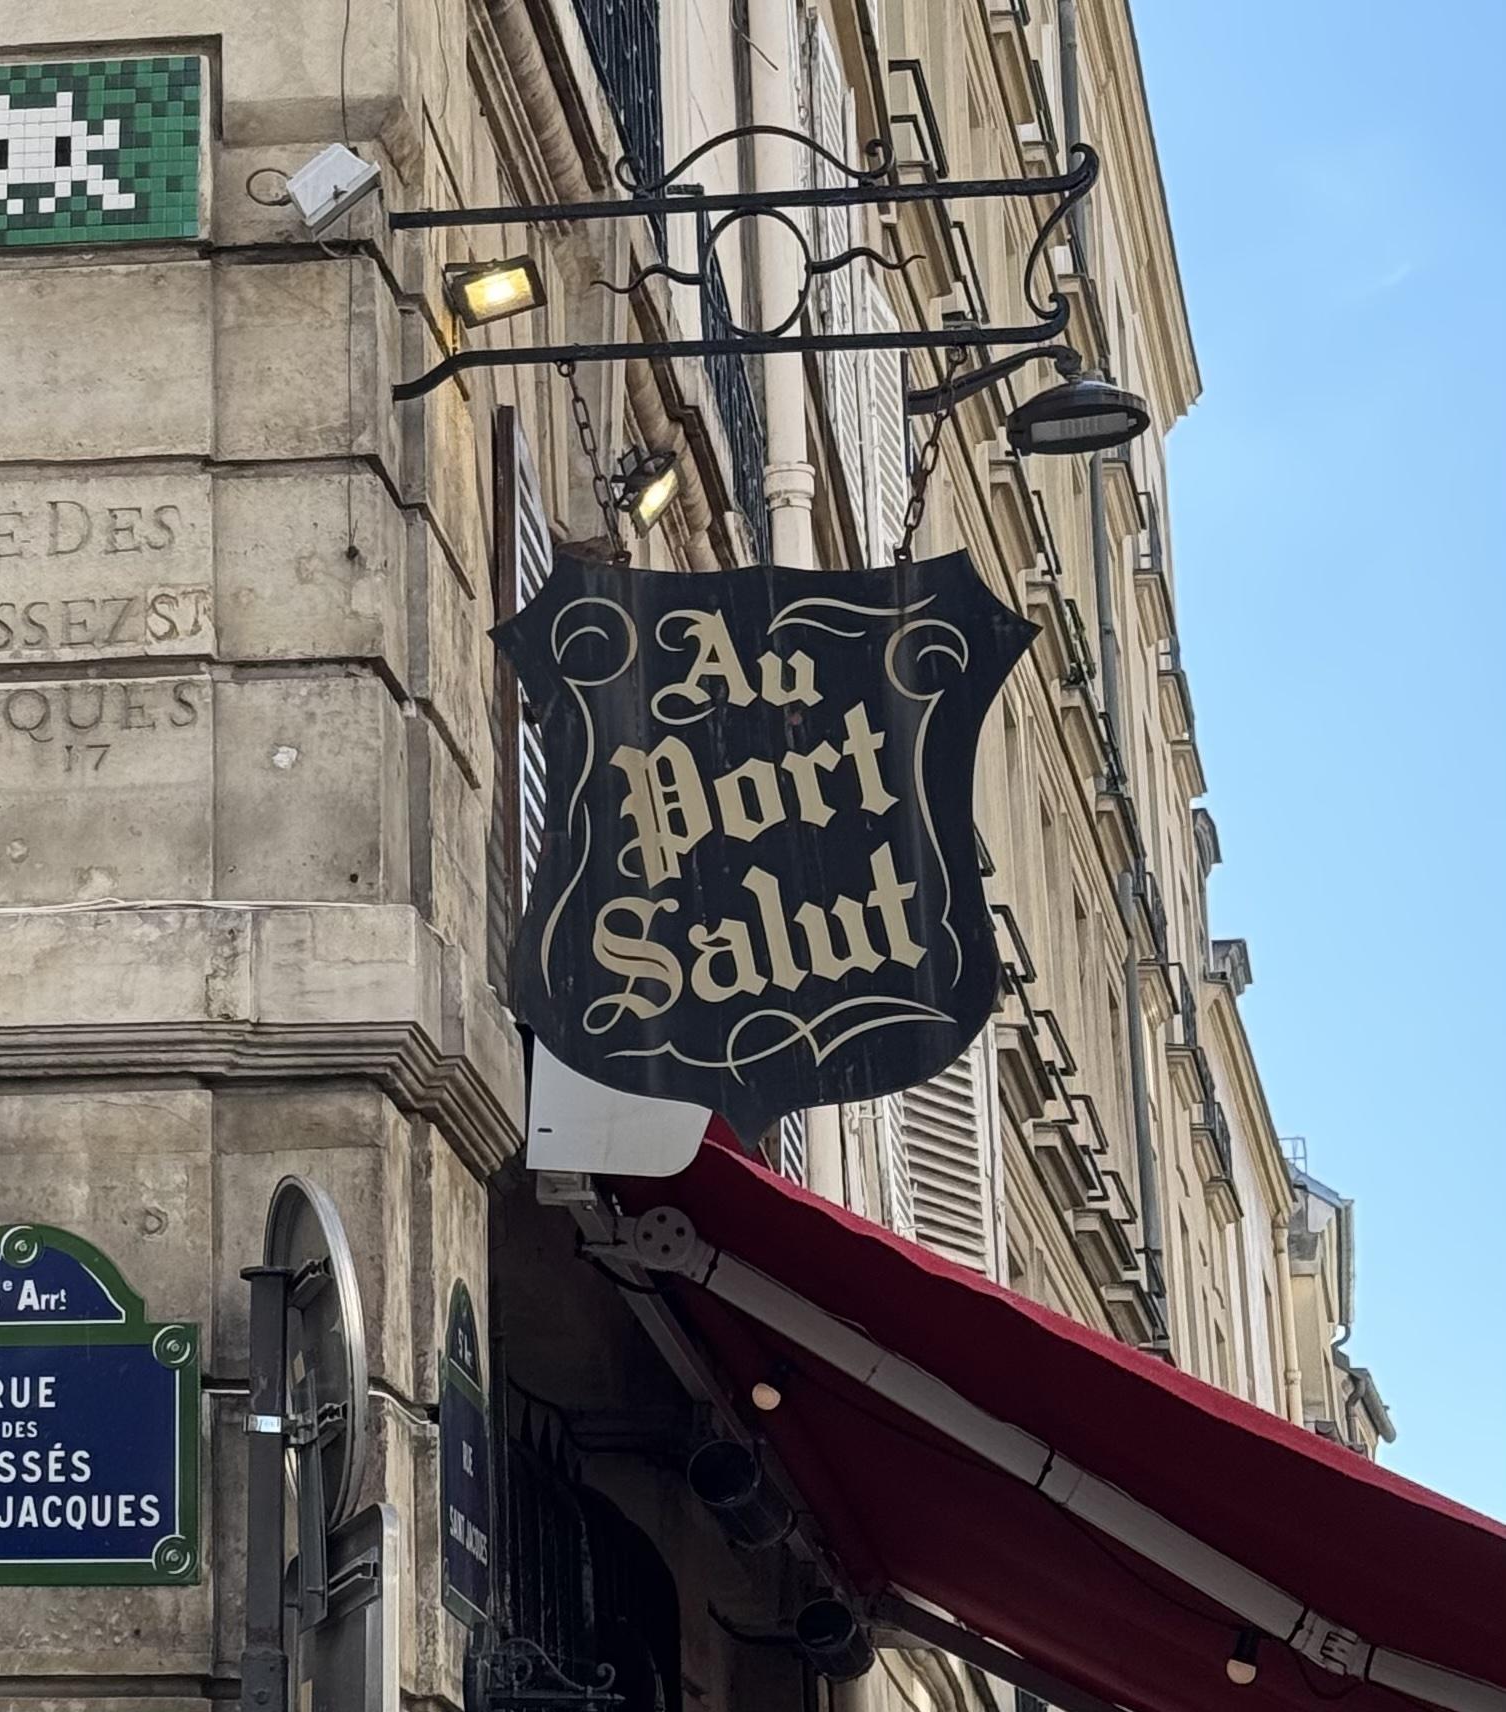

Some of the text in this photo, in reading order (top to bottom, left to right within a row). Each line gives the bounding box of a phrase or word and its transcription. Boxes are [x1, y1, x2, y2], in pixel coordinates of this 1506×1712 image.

[47, 499, 182, 557] DES
[650, 609, 824, 725] Au
[64, 744, 111, 772] 17
[609, 702, 900, 889] Port
[583, 841, 928, 1035] Salut
[1, 1421, 39, 1438] DES
